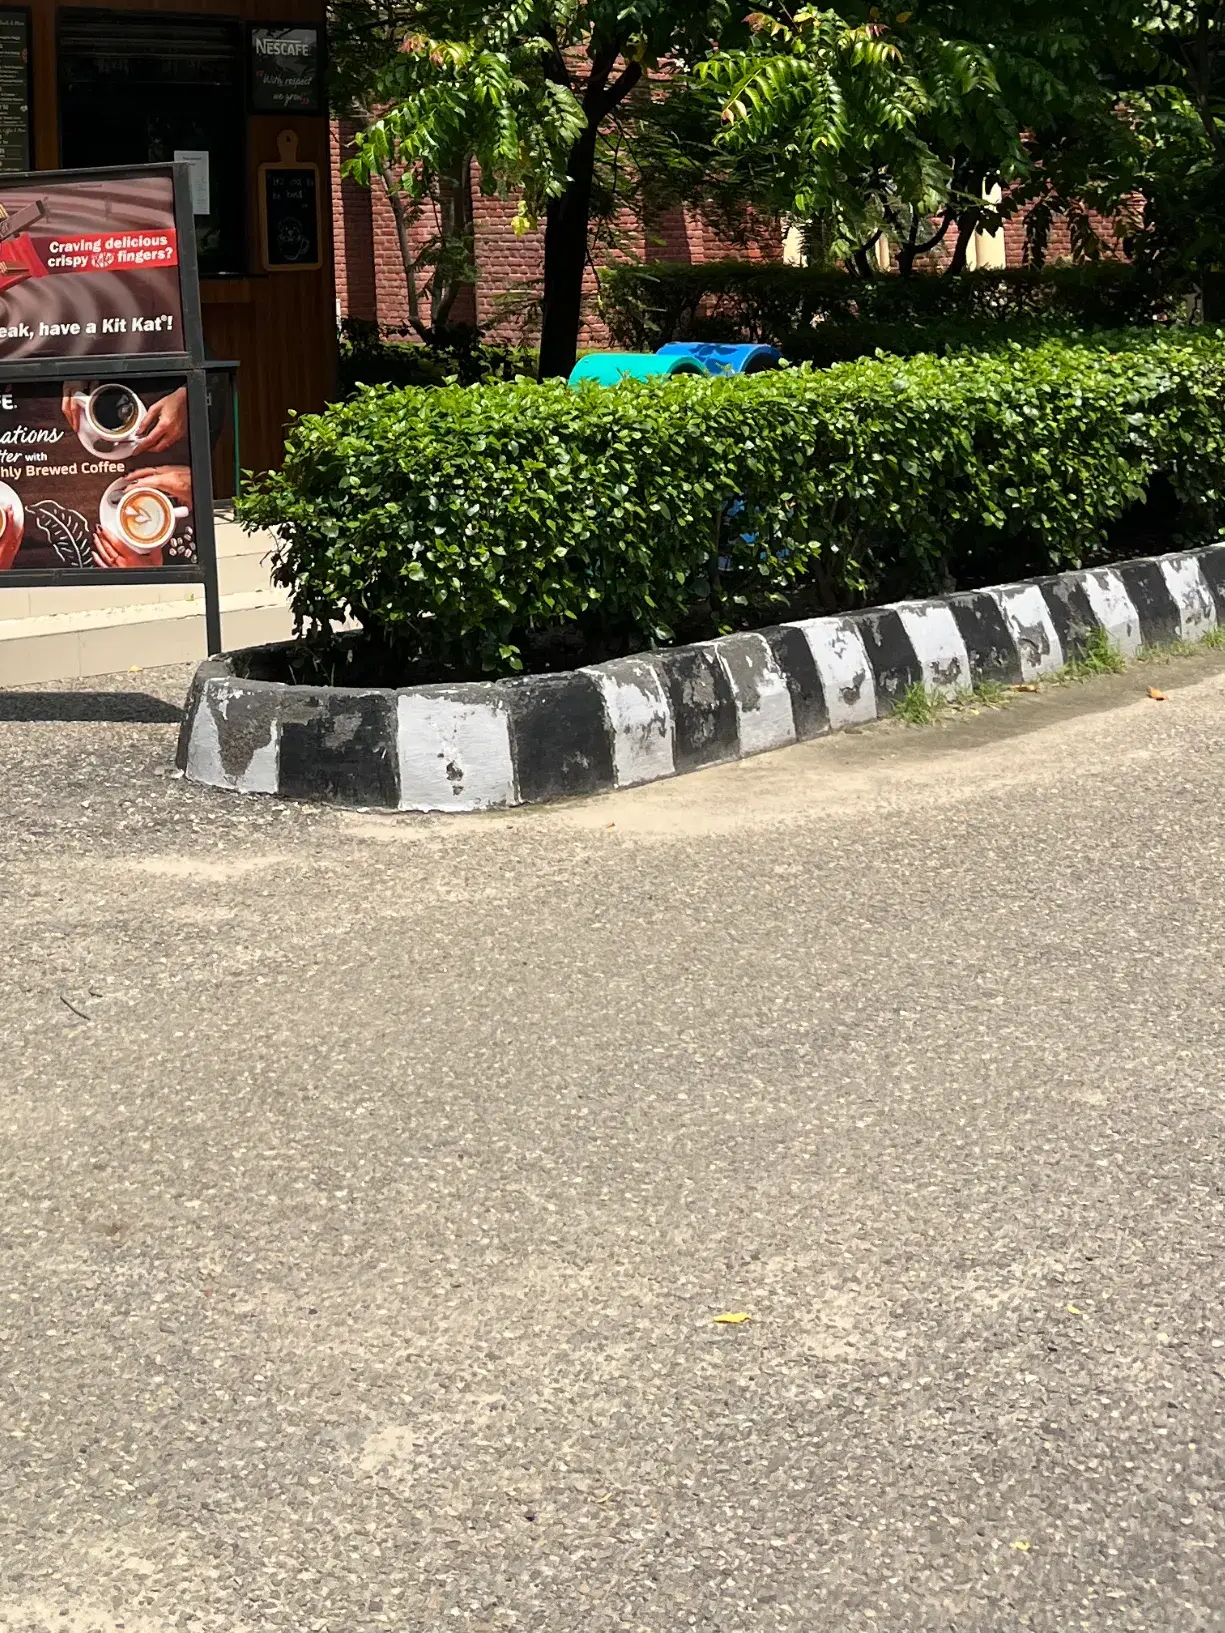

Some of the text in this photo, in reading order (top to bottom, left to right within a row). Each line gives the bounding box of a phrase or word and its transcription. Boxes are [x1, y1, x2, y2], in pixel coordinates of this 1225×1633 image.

[49, 235, 168, 253] Craving delicious
[47, 254, 88, 268] crispy
[117, 248, 174, 263] fingers?
[39, 322, 80, 336] have
[86, 323, 96, 335] a
[102, 318, 126, 333] Kit
[25, 452, 48, 462] with
[26, 464, 77, 477] Brewed
[81, 461, 125, 474] Coffee
